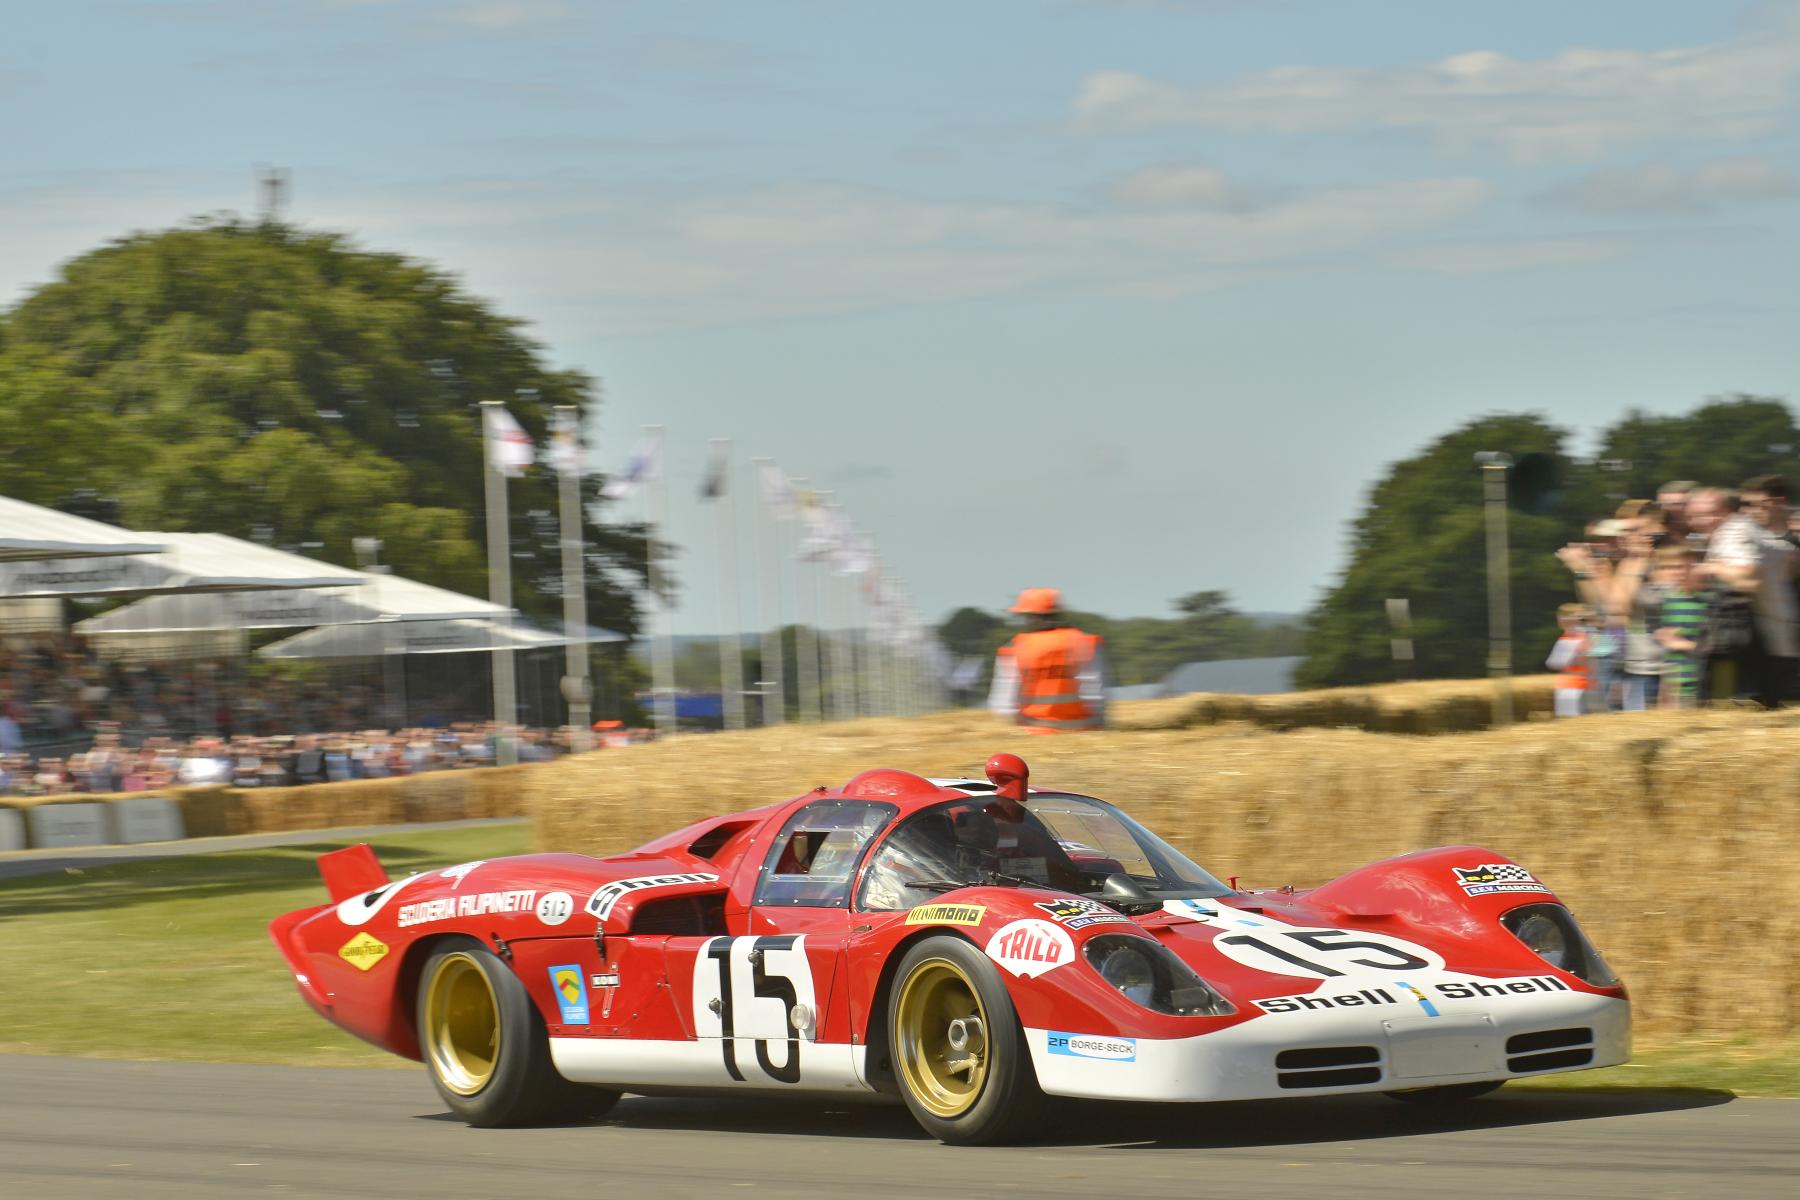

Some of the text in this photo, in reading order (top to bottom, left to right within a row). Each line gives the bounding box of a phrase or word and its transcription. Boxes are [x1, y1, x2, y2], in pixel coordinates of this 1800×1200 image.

[543, 900, 567, 917] 512
[591, 873, 714, 915] Shell
[1219, 929, 1429, 977] 15
[707, 935, 801, 1084] 15
[1260, 976, 1567, 1014] Shell Shell
[1048, 1037, 1133, 1054] 2P BORGE-SECK
